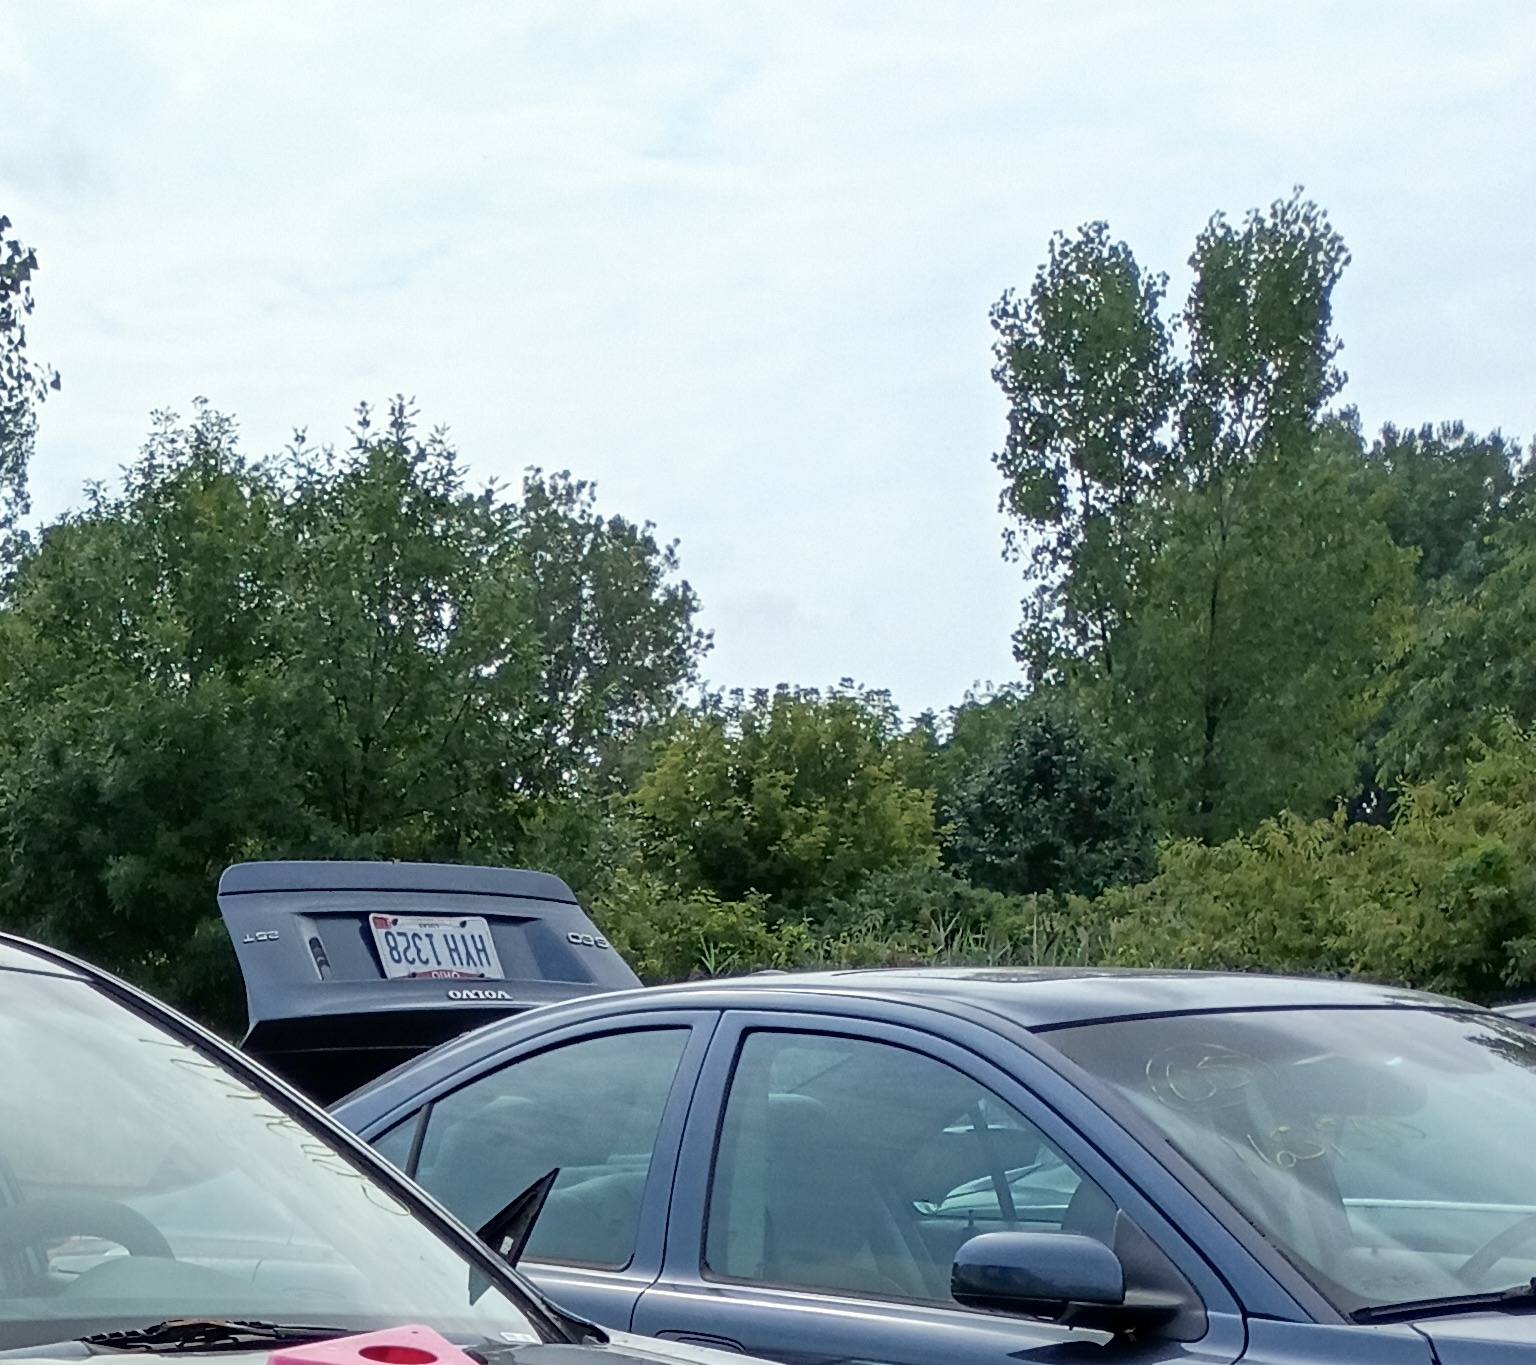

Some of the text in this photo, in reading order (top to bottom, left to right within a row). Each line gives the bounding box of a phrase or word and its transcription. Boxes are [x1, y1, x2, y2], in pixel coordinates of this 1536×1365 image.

[384, 931, 491, 967] HYH 1328
[448, 990, 513, 1000] VOLVO
